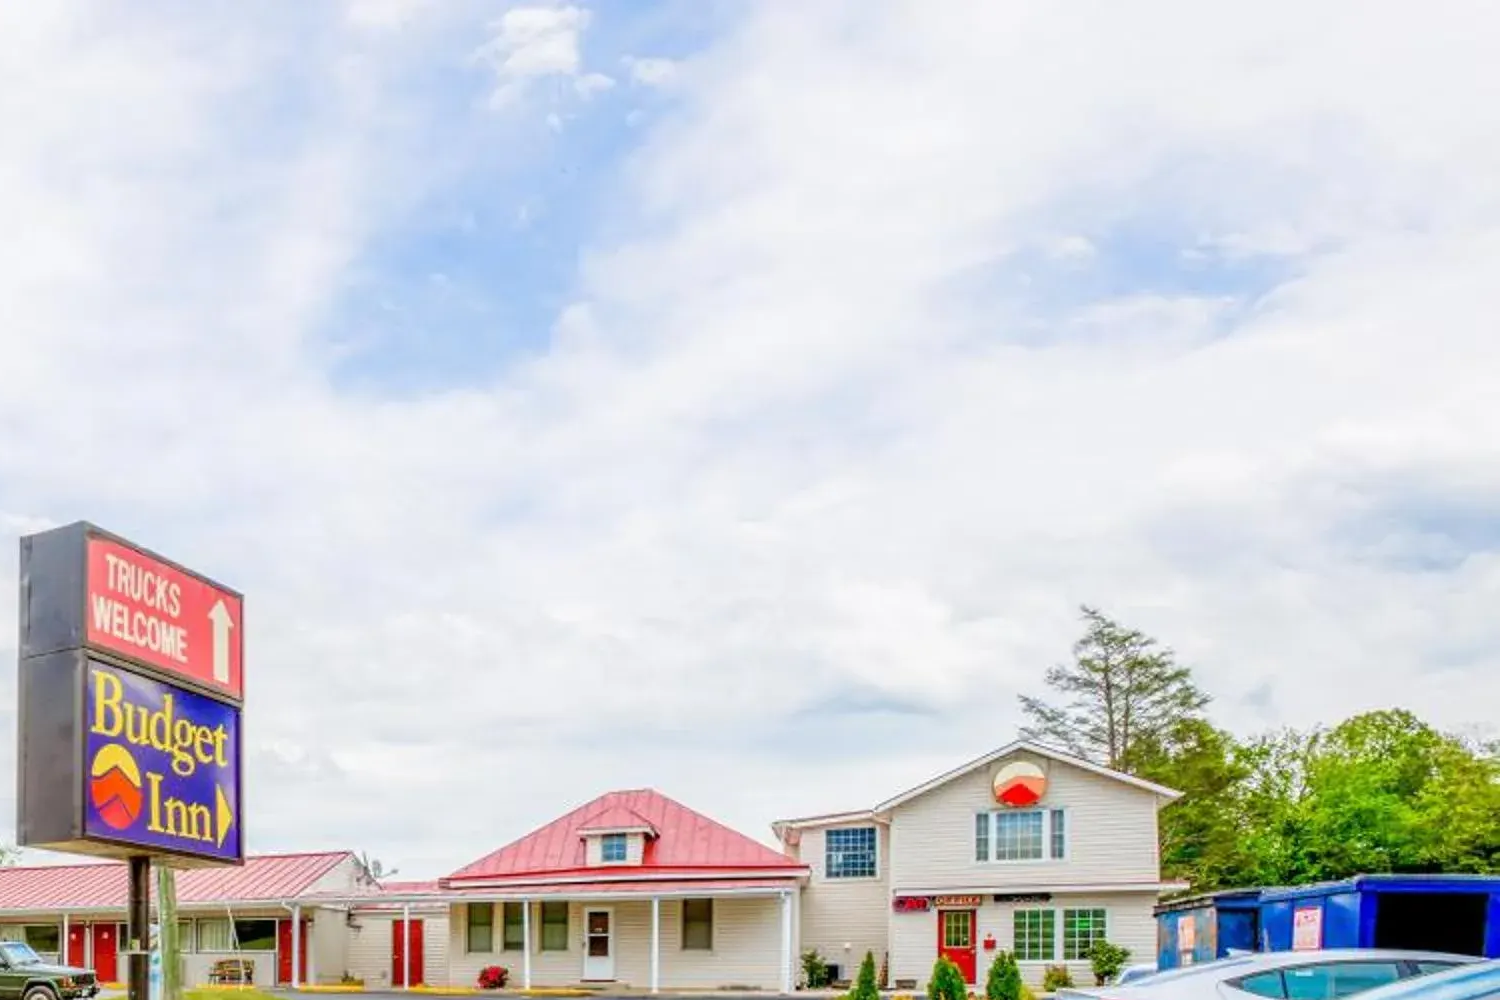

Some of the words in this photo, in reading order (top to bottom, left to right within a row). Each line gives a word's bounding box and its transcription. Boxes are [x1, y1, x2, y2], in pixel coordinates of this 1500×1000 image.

[106, 554, 181, 617] TRUCKS
[91, 594, 189, 664] WELCOME
[90, 669, 229, 776] Budget
[147, 772, 214, 842] Inn
